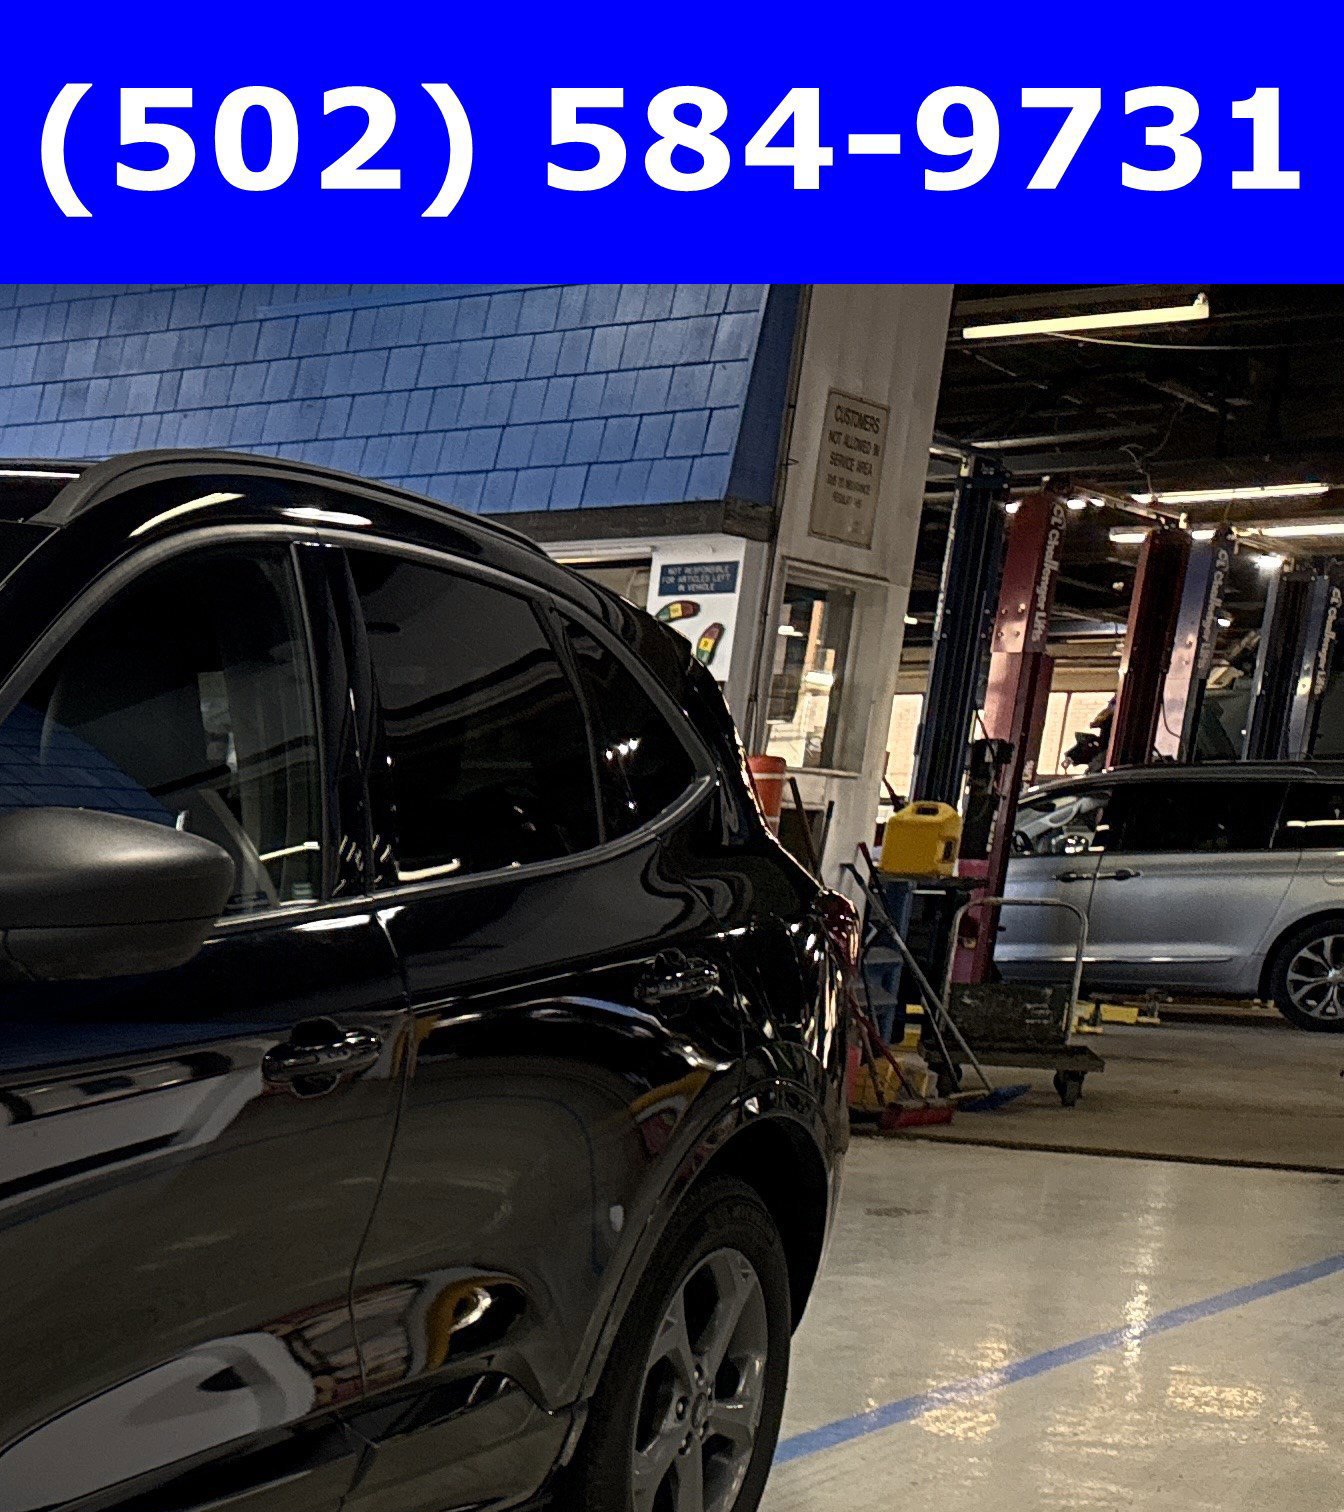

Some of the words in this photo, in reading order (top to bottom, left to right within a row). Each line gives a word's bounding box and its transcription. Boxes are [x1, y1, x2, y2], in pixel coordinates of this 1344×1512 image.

[834, 405, 880, 434] CUSTOMERS
[830, 451, 855, 472] SERVICE
[1035, 529, 1061, 611] Challenger
